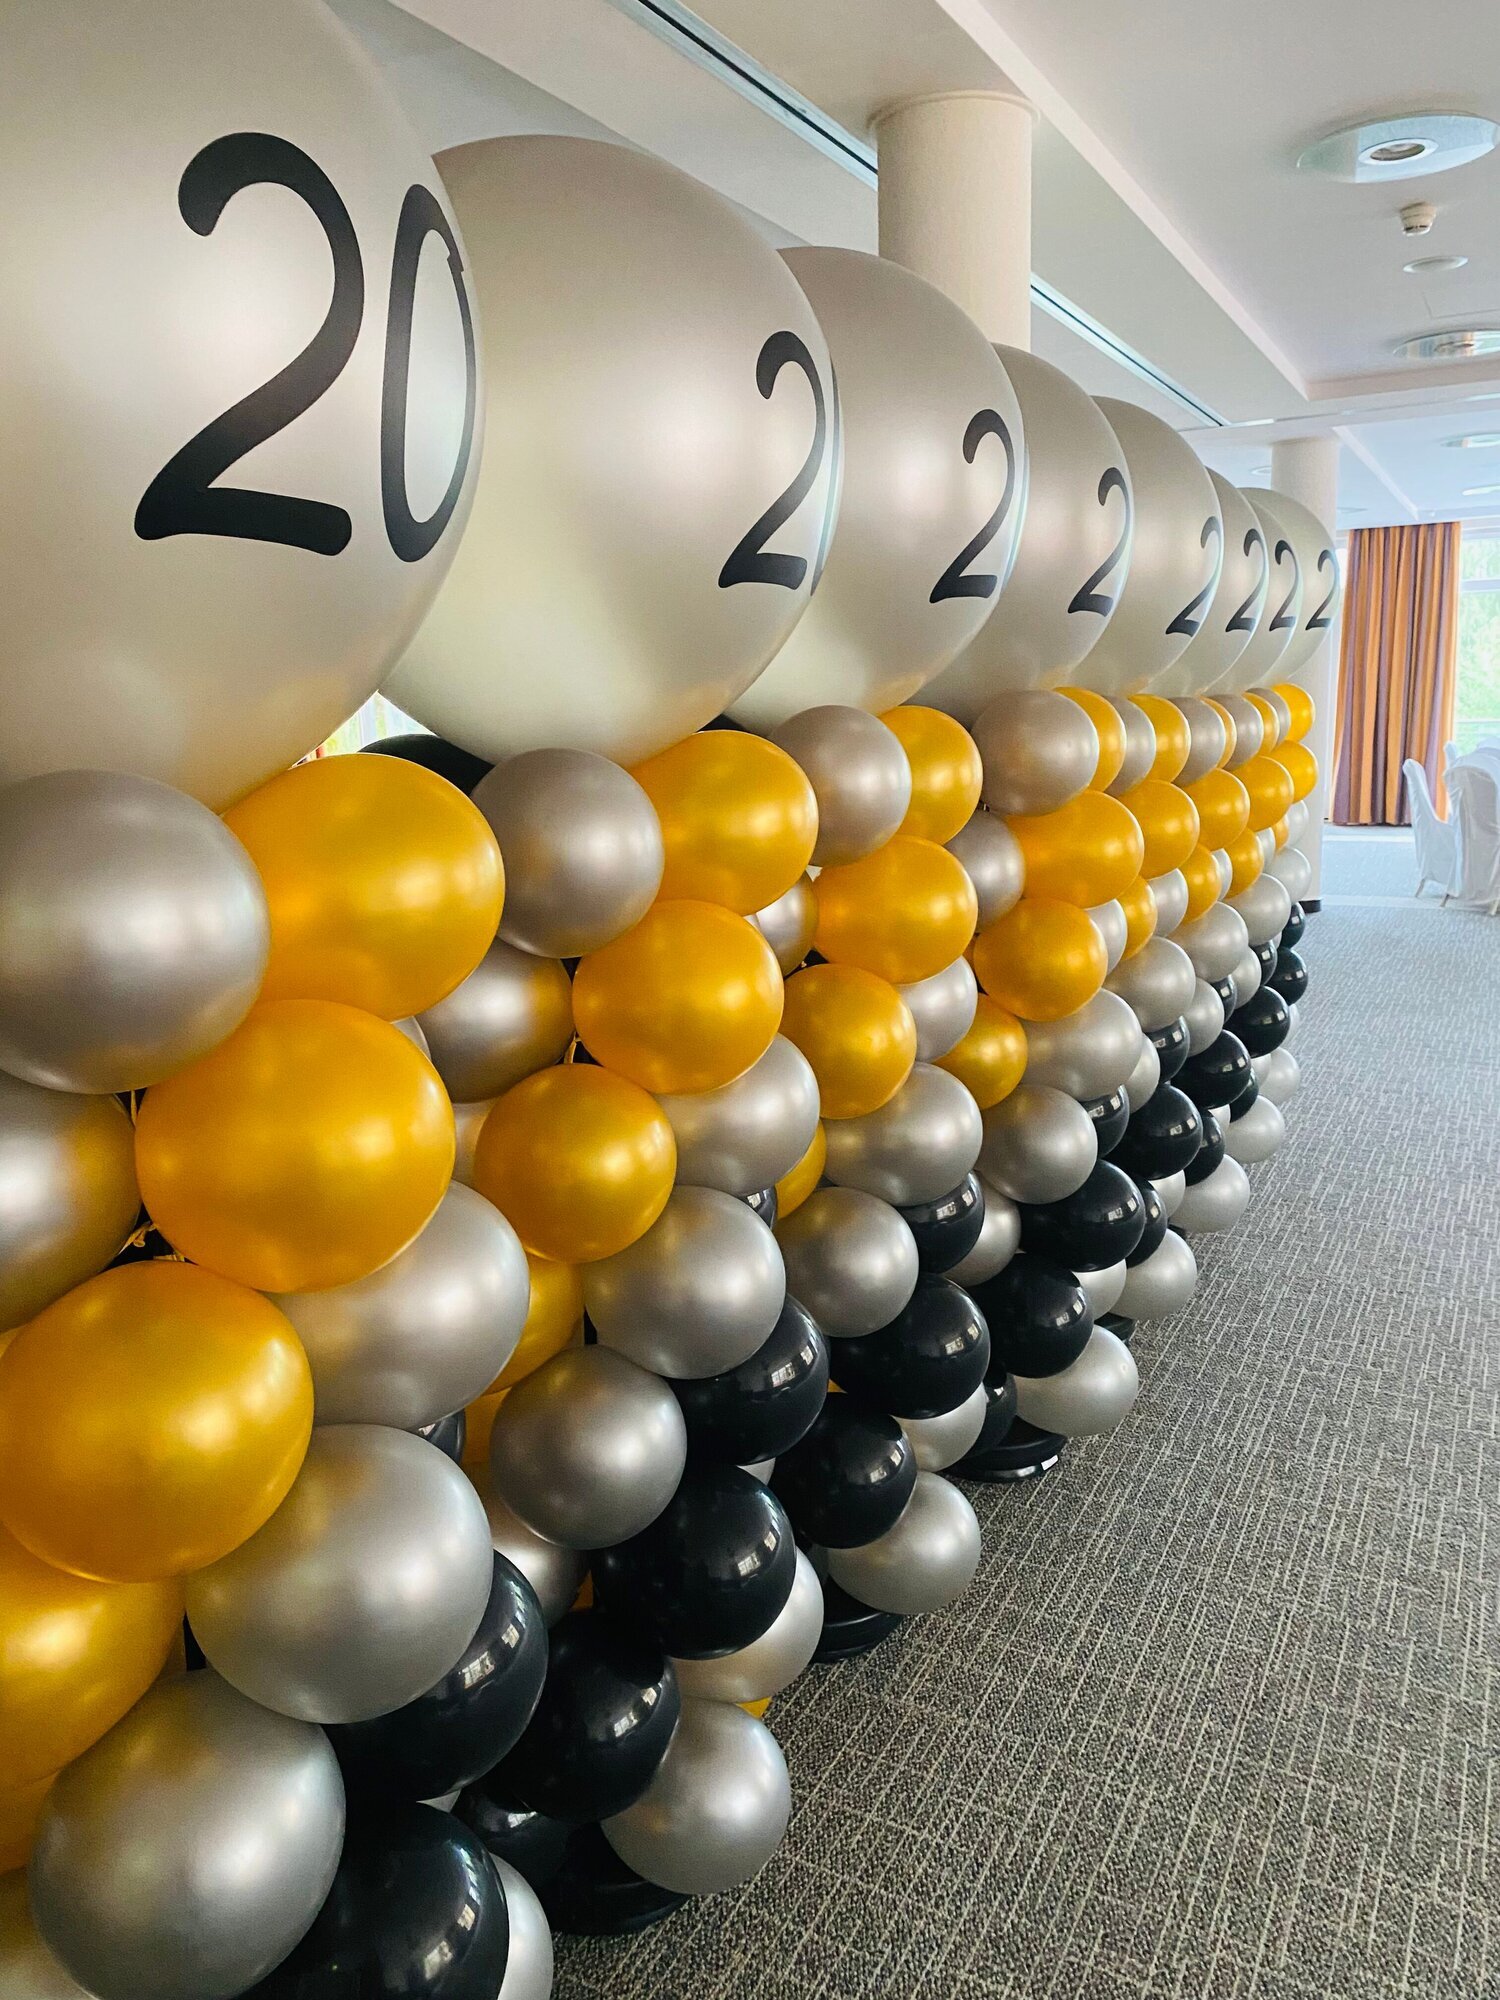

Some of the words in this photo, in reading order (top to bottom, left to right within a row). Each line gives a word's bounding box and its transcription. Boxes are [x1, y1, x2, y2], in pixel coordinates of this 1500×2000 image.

[134, 132, 476, 562] 20
[718, 331, 839, 596] 2
[929, 408, 1027, 603] 2
[1068, 467, 1130, 617] 2
[1165, 516, 1222, 637] 2
[1225, 528, 1265, 632] 2
[1269, 540, 1299, 631] 2
[1305, 550, 1339, 630] 2
